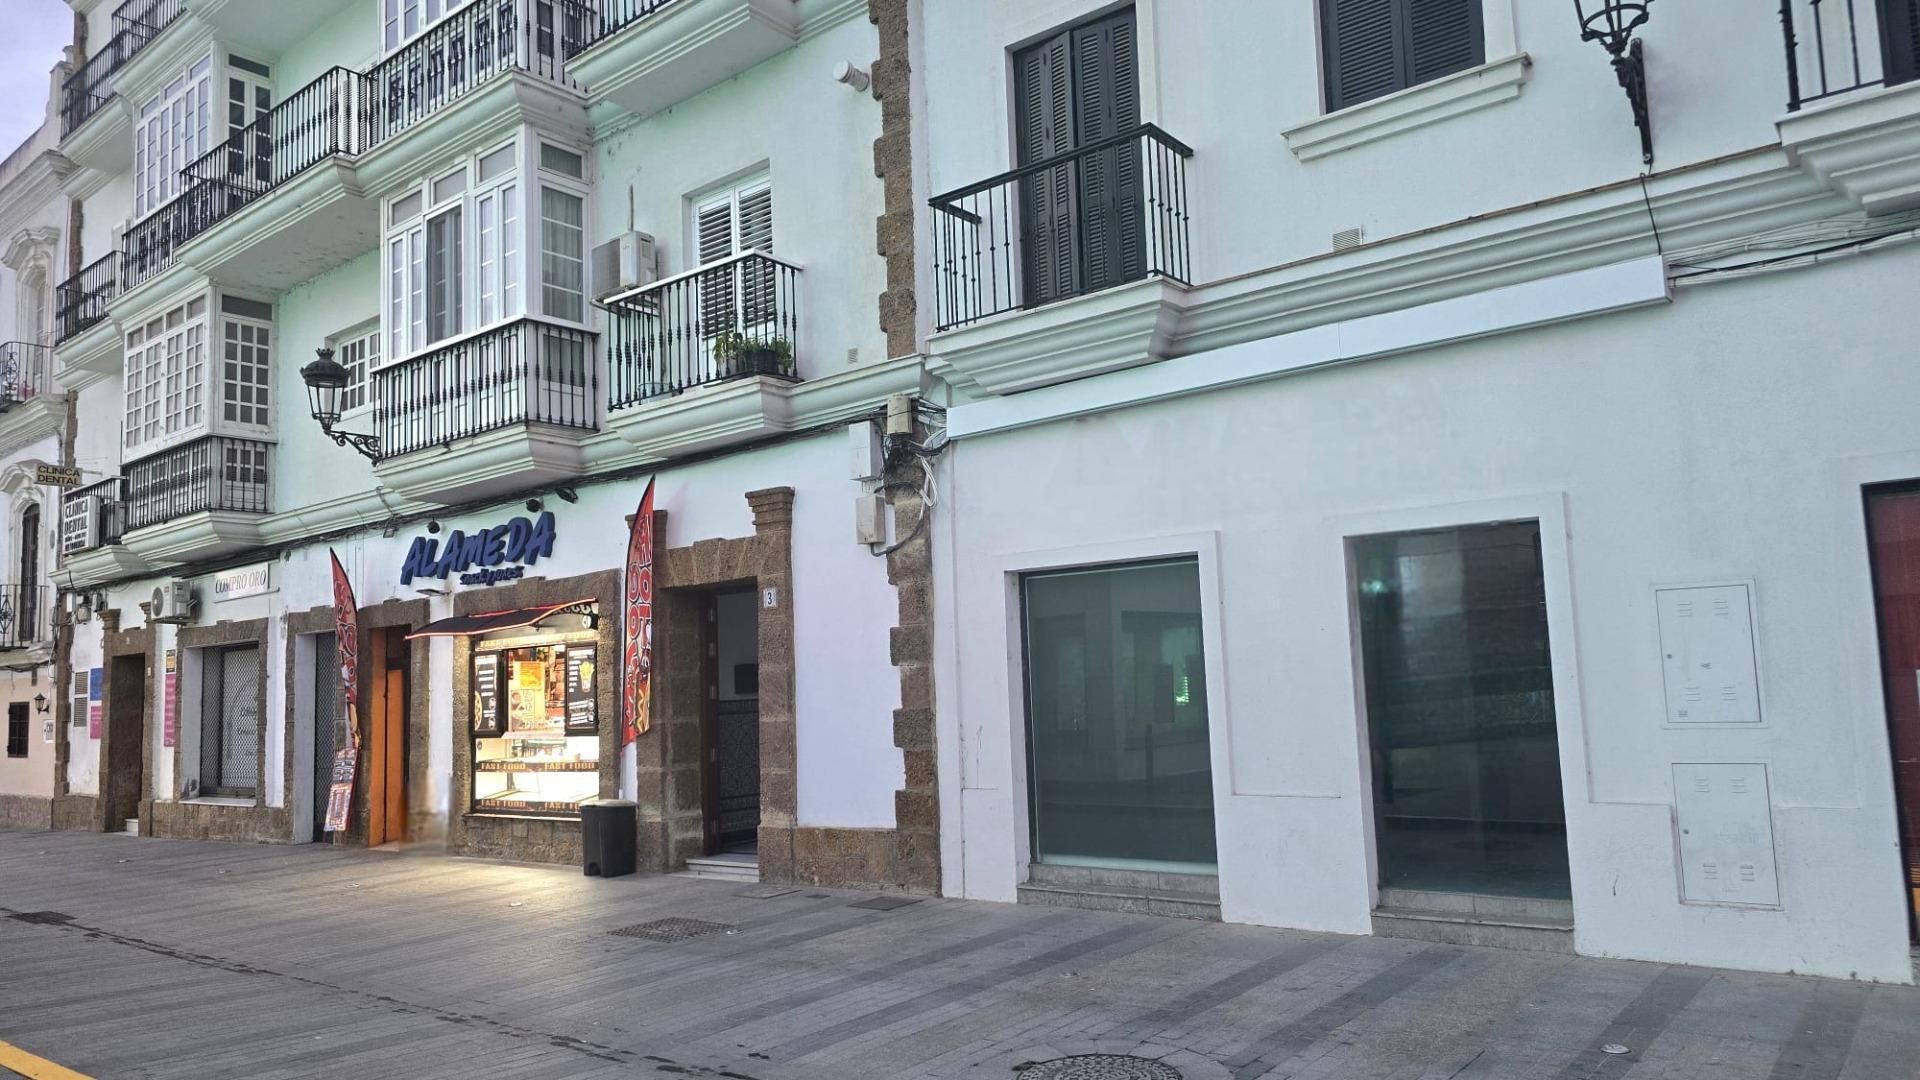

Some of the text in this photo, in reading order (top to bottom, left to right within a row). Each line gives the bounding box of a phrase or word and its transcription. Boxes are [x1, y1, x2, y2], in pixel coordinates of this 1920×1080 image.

[38, 465, 81, 477] CLINICA
[37, 474, 81, 485] DENTAL
[64, 515, 88, 535] DENTAL
[400, 511, 556, 585] ALAMEDA
[215, 569, 267, 594] COMPRO ORO
[767, 591, 773, 605] 3
[481, 761, 595, 770] FAST FOOD FAST FOOD
[481, 799, 500, 808] FAST
[503, 800, 526, 808] FOOD
[544, 801, 566, 809] FAST
